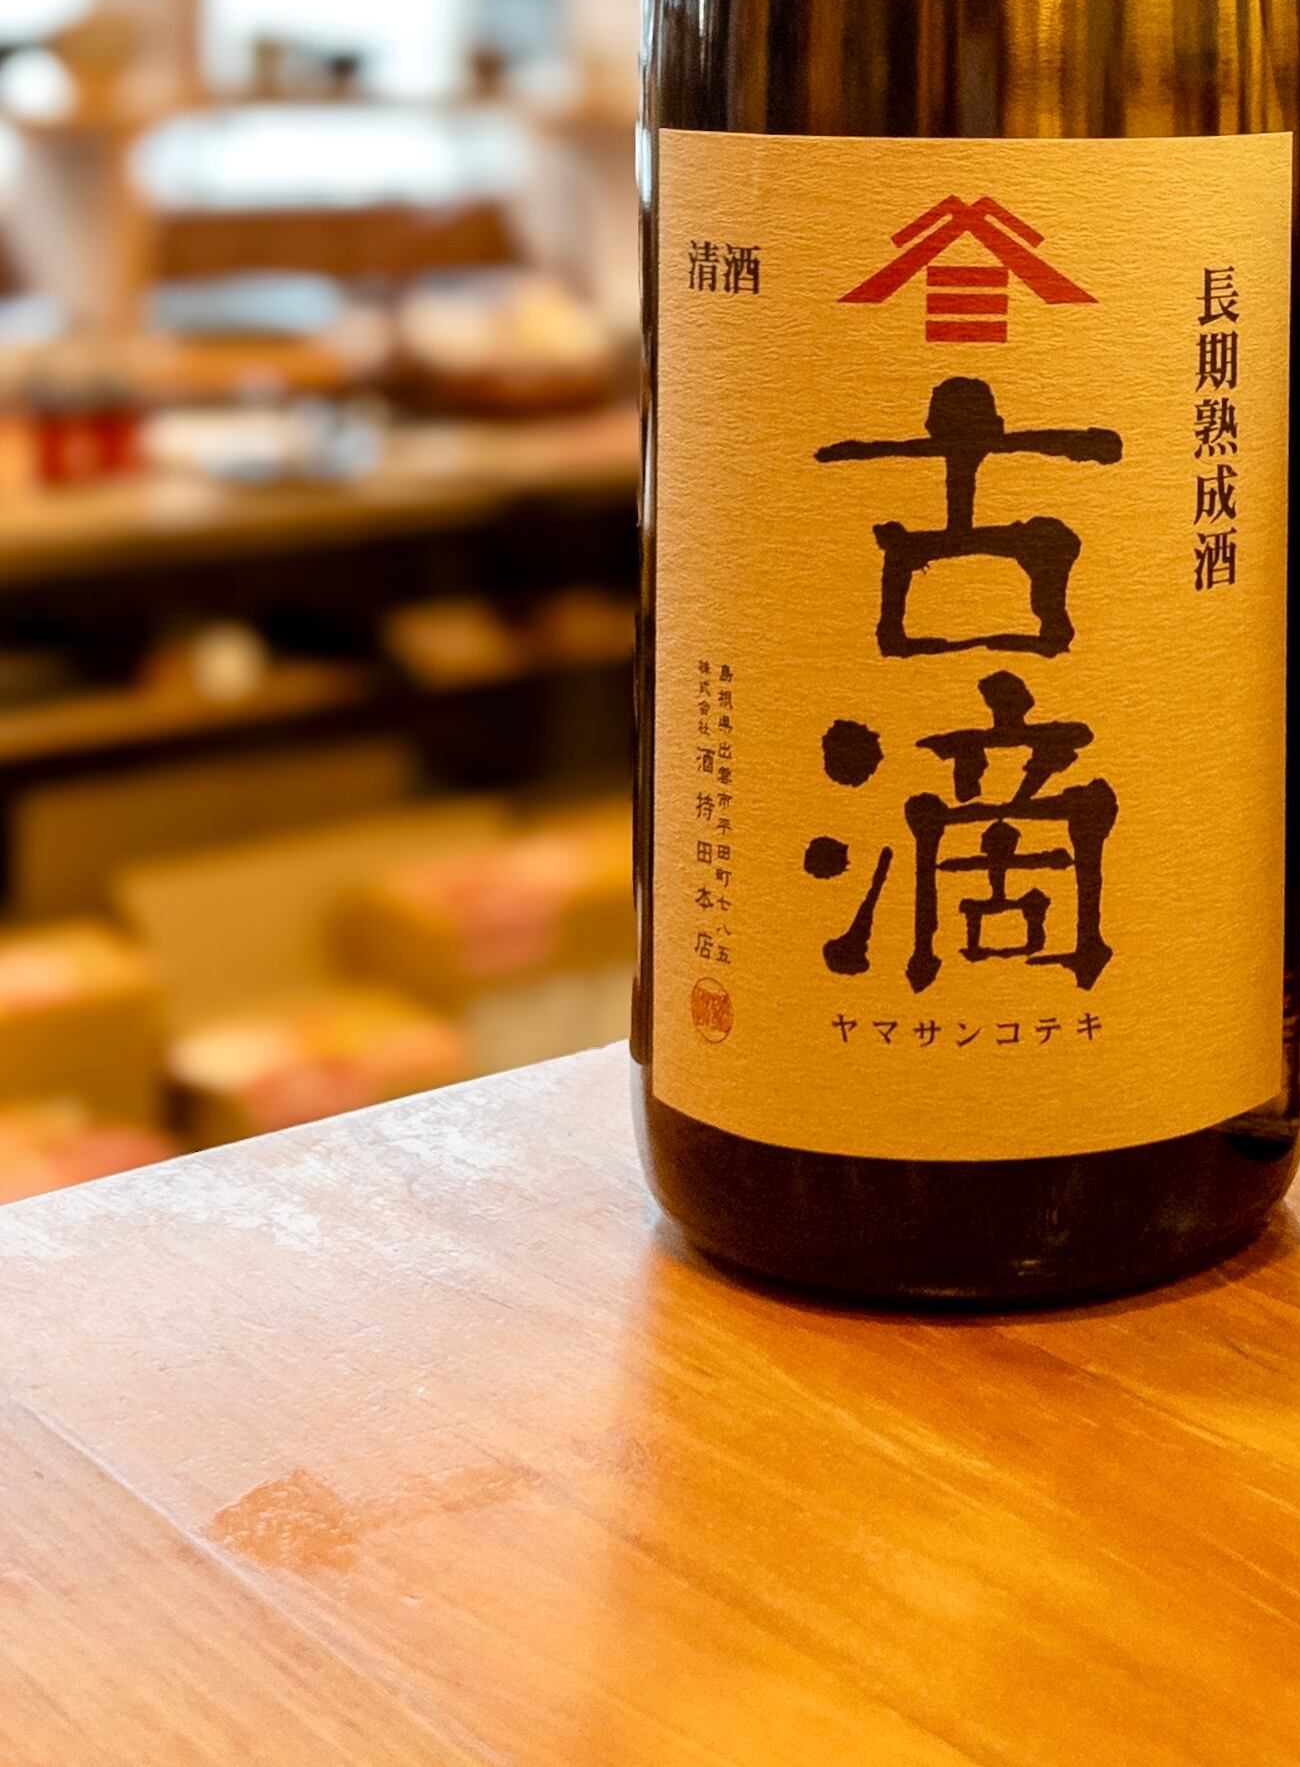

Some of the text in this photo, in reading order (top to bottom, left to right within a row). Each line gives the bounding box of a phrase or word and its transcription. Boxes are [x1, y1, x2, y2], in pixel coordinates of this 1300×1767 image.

[688, 239, 762, 295] 清酒
[1193, 266, 1240, 592] 長期熟成酒
[804, 376, 1123, 994] 古滴
[831, 1012, 1102, 1048] ヤマサンコテキ
